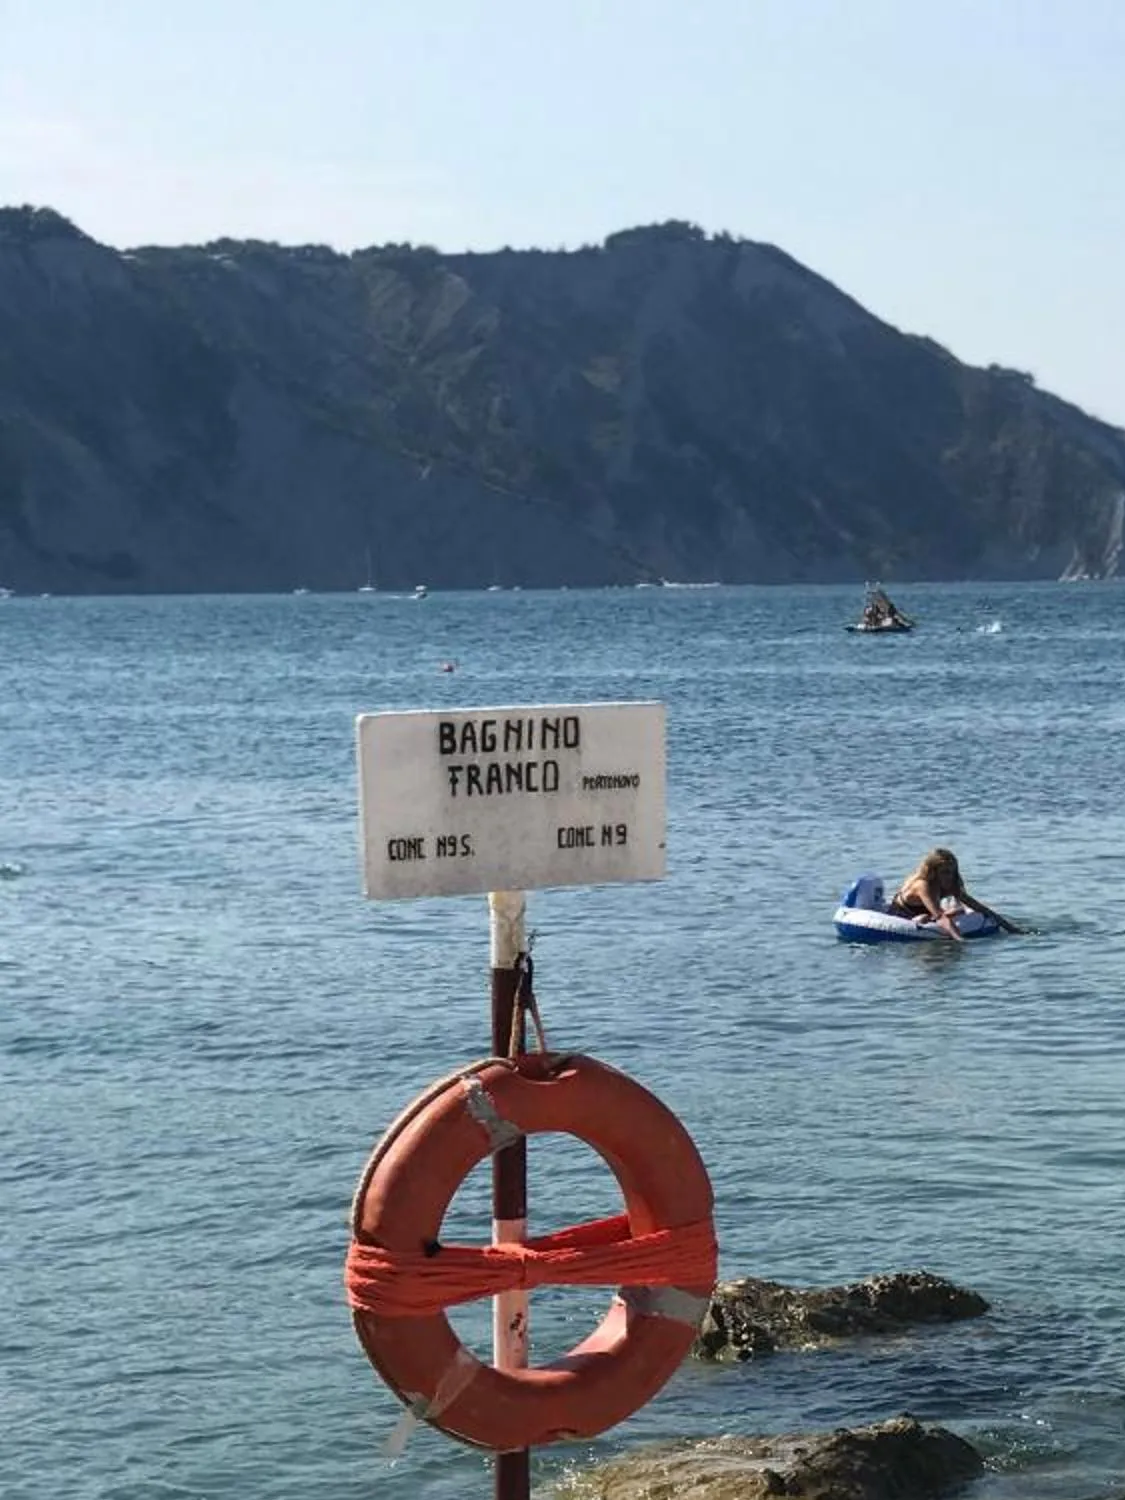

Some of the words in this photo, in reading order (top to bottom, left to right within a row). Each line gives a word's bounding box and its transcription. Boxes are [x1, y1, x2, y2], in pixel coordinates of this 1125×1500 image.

[439, 716, 580, 755] BAGNINO
[447, 760, 560, 797] FRANCO
[388, 837, 426, 861] CONC
[557, 826, 595, 849] CONC
